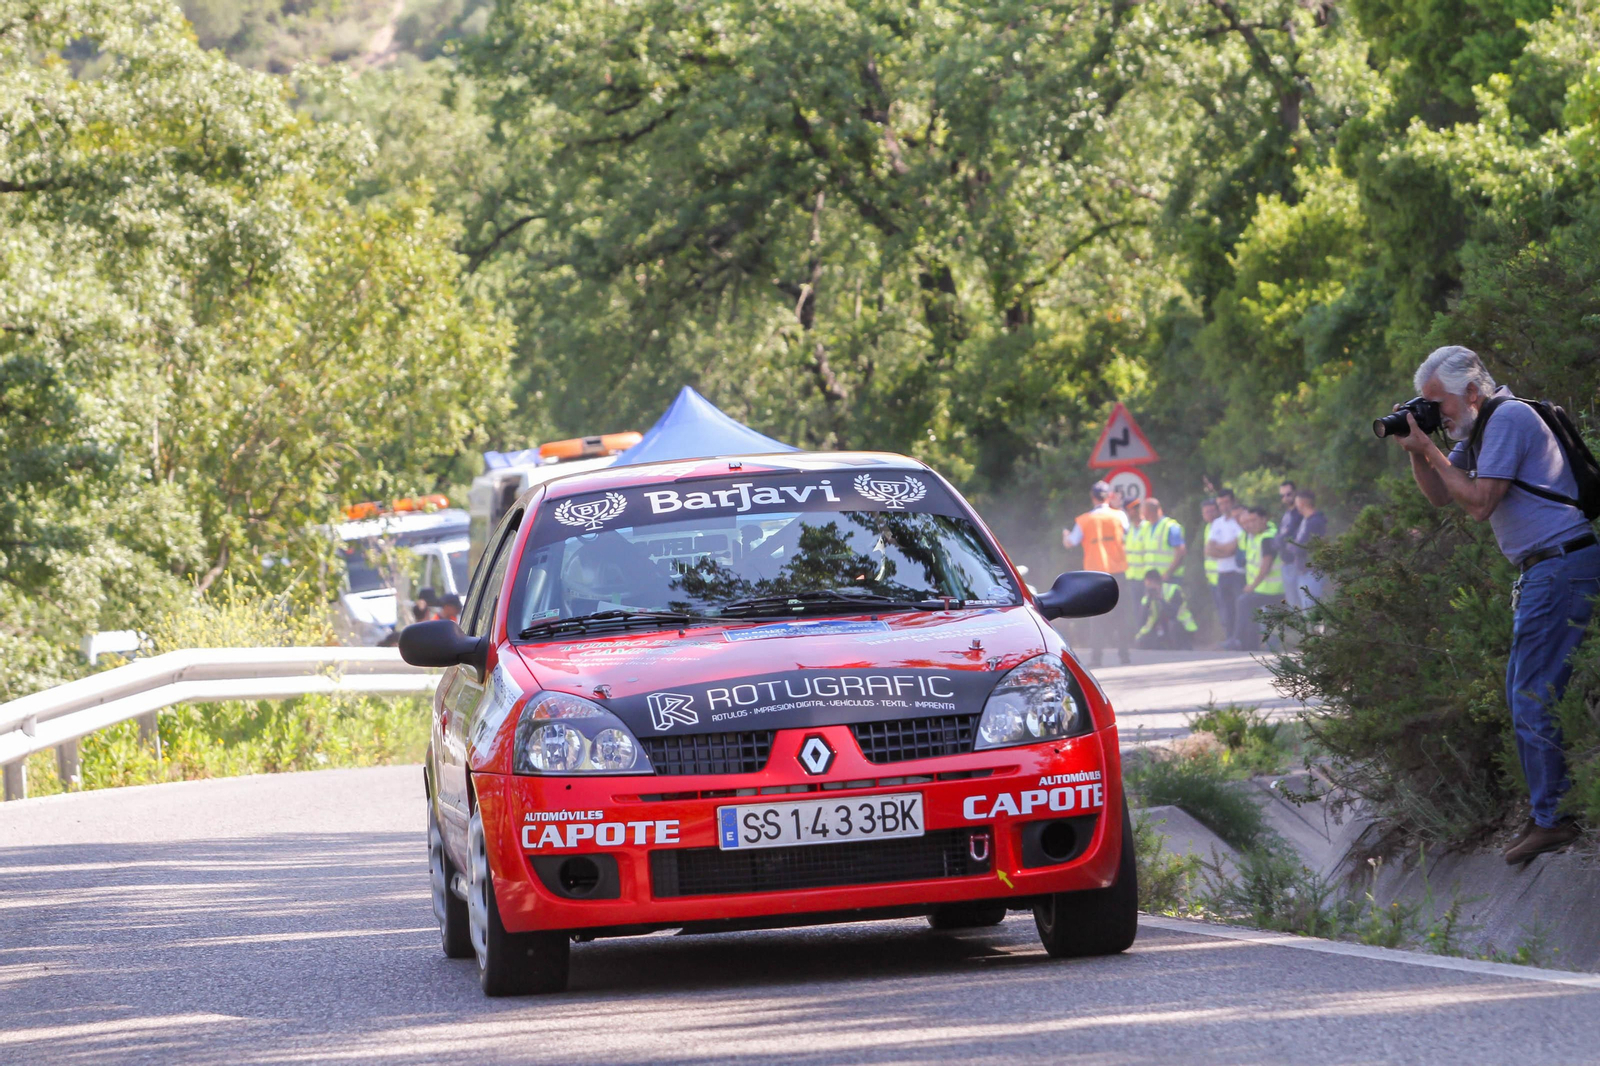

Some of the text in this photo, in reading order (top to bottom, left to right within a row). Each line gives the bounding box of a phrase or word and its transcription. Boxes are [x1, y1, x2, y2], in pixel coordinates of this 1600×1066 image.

[644, 480, 840, 514] BarJavi
[878, 483, 900, 496] BJ
[578, 503, 600, 516] BJ
[706, 675, 954, 711] ROTUGRAFIC
[711, 709, 748, 722] ROTULOS
[796, 700, 826, 709] DIGITAL
[880, 699, 908, 708] TEXTIL
[915, 701, 955, 711] IMPRENTA
[963, 783, 1104, 820] CAPOTE
[524, 809, 603, 822] AUTOMÓVILES
[521, 819, 680, 849] CAPOTE
